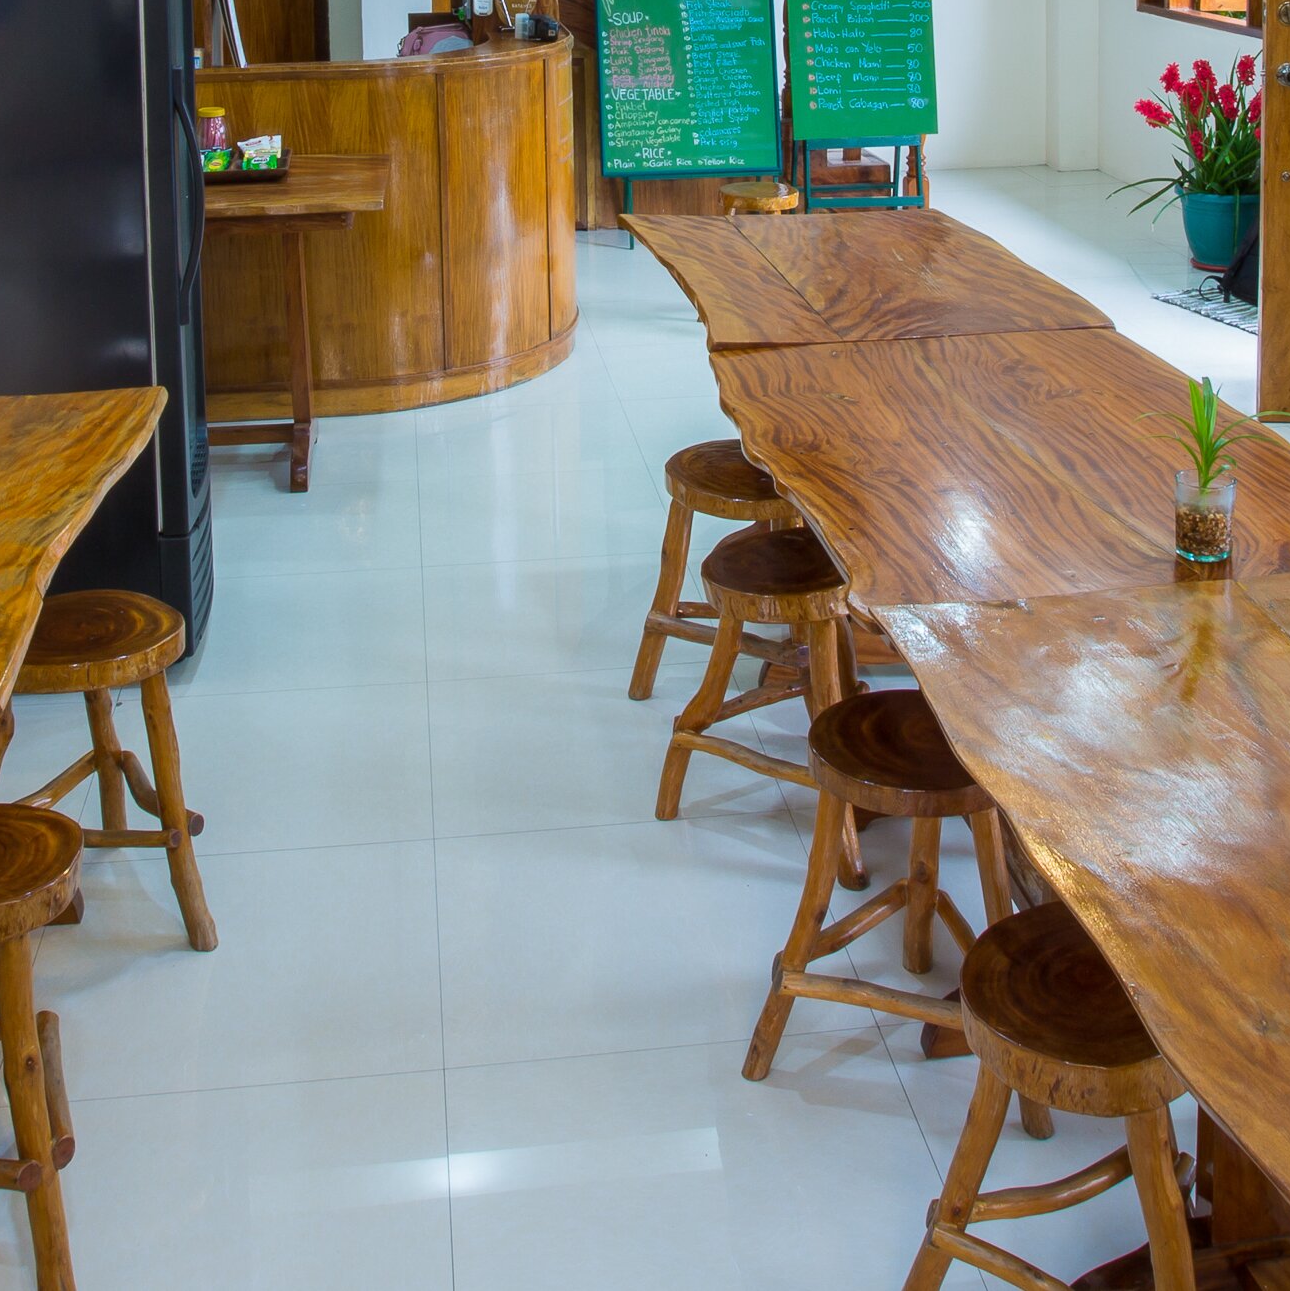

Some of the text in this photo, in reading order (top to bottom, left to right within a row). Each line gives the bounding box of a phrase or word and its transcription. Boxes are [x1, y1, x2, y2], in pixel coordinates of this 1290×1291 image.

[686, 1, 703, 9] Fish
[811, 1, 844, 13] Creamy
[612, 11, 644, 26] SOUP
[811, 12, 839, 24] Pancit
[909, 14, 930, 23] 200
[909, 28, 922, 38] 80
[907, 44, 923, 53] 50
[814, 57, 851, 68] Chicken
[907, 72, 921, 82] 80
[611, 88, 675, 101] VEGETABLE
[818, 86, 841, 94] Lomi
[910, 98, 925, 109] 80
[642, 148, 666, 159] RICE
[613, 159, 636, 169] Plain
